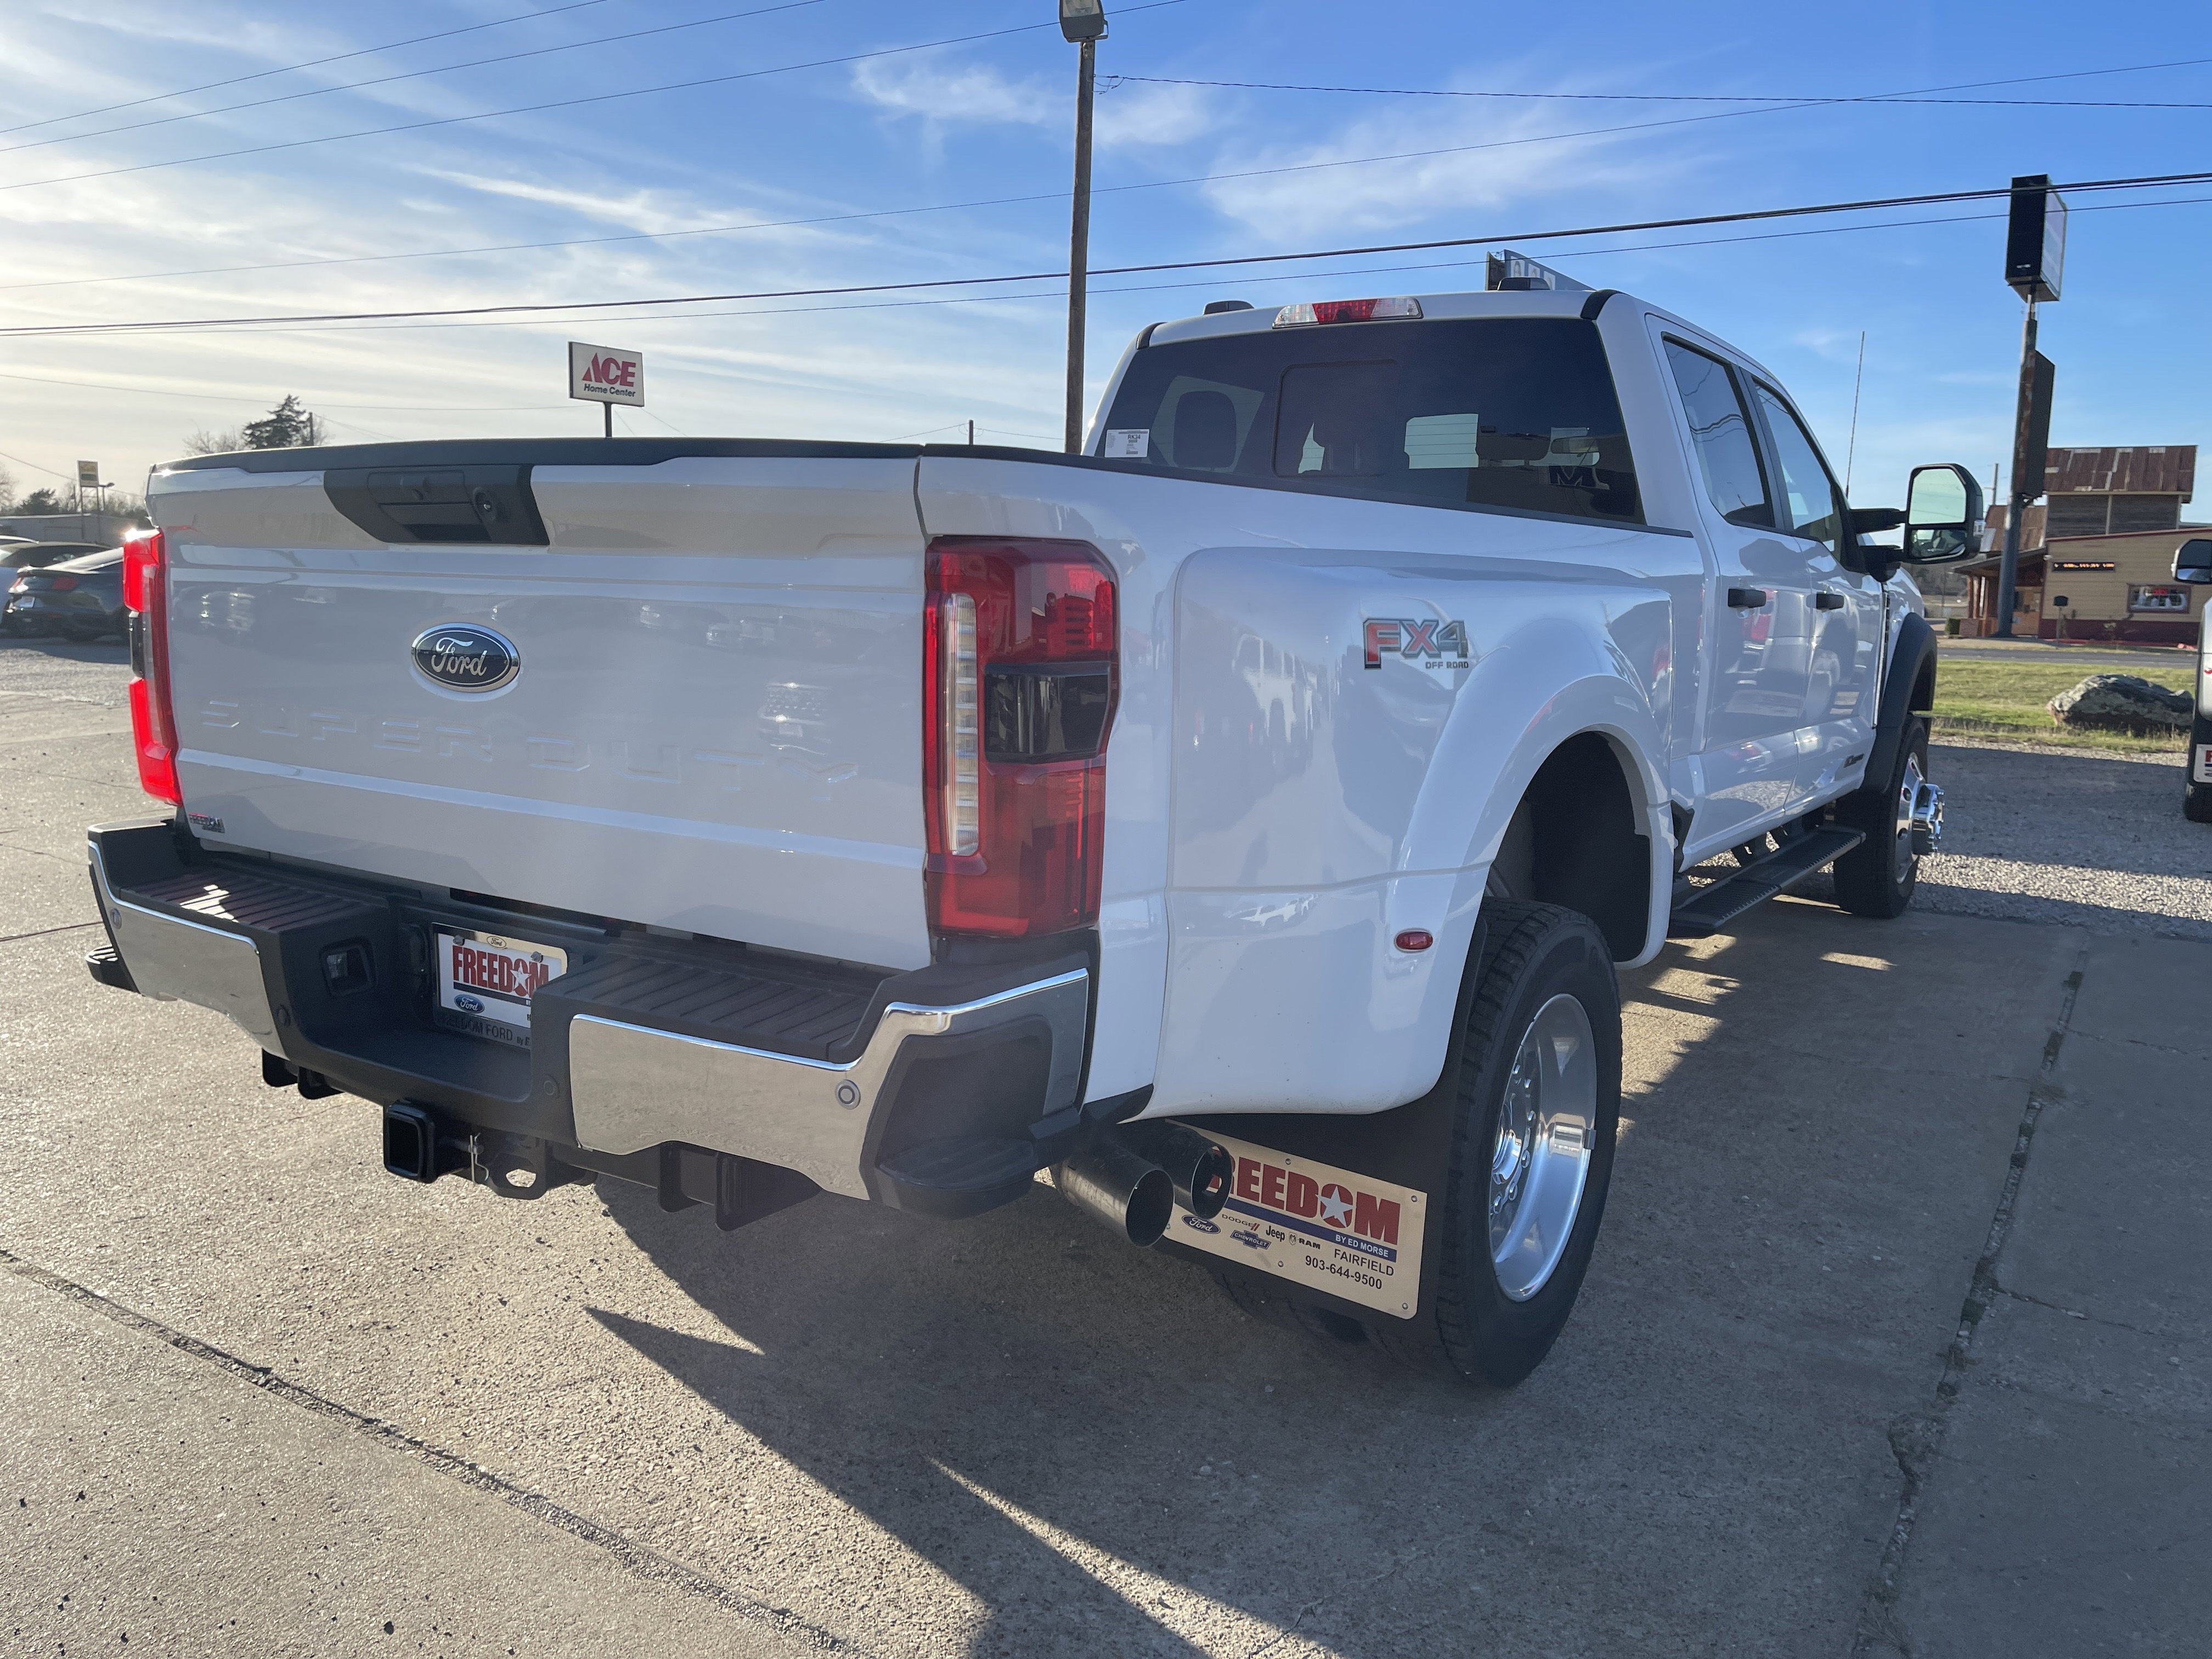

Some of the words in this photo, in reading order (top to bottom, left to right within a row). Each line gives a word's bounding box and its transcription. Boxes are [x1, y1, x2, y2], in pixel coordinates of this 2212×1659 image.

[582, 353, 636, 387] ACE
[584, 383, 607, 394] Home
[609, 386, 636, 397] Center
[1363, 618, 1469, 670] FX4
[431, 637, 488, 676] Ford
[452, 945, 549, 998] FREEDOM
[486, 1025, 513, 1041] FORD
[1229, 1155, 1401, 1245] EEDOM
[1189, 1217, 1214, 1232] Ford
[1221, 1214, 1254, 1228] DODGE
[1234, 1232, 1268, 1247] CHEVROLET
[1265, 1225, 1285, 1243] Jeep
[1299, 1238, 1321, 1250] RAM
[1335, 1234, 1347, 1244] BY
[1347, 1237, 1359, 1248] ED
[1360, 1242, 1389, 1258] MORSE
[1305, 1255, 1383, 1290] 903-644-9500
[1334, 1248, 1394, 1276] FAIRFIELD
